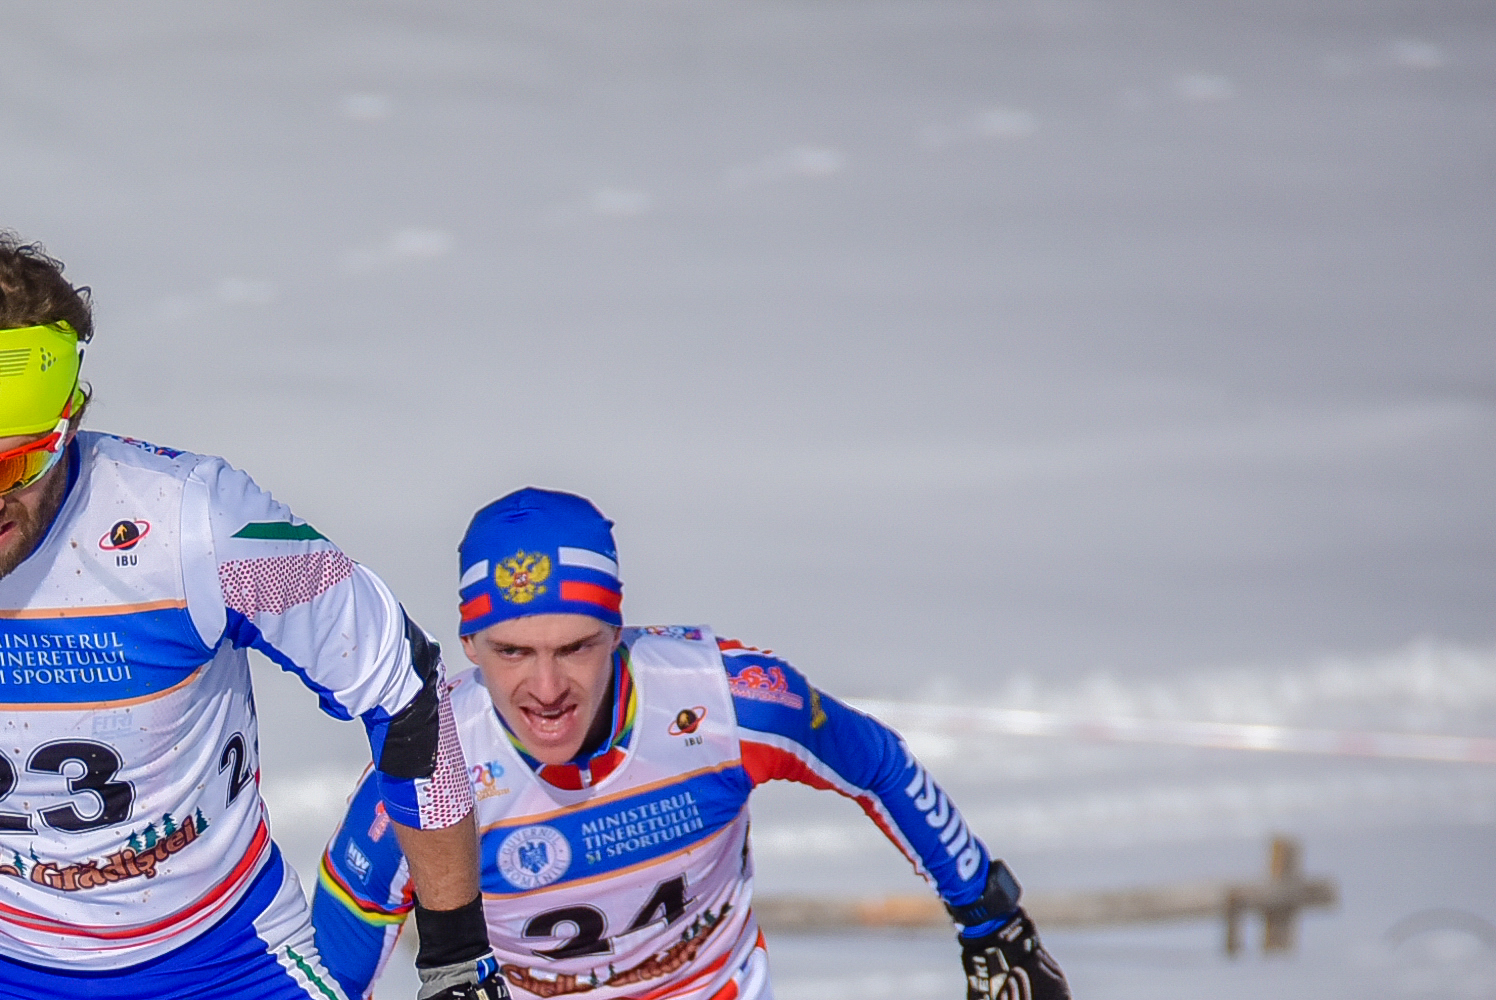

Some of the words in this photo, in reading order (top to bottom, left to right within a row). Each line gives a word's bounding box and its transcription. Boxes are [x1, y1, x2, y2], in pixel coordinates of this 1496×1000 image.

[116, 555, 138, 566] IBU
[13, 665, 132, 685] SPORTULUI
[684, 736, 703, 747] IBU
[581, 791, 696, 836] MINISTERUL
[582, 805, 699, 850] TINERETULUI
[607, 816, 703, 857] SPORTULUI
[521, 872, 699, 962] 24
